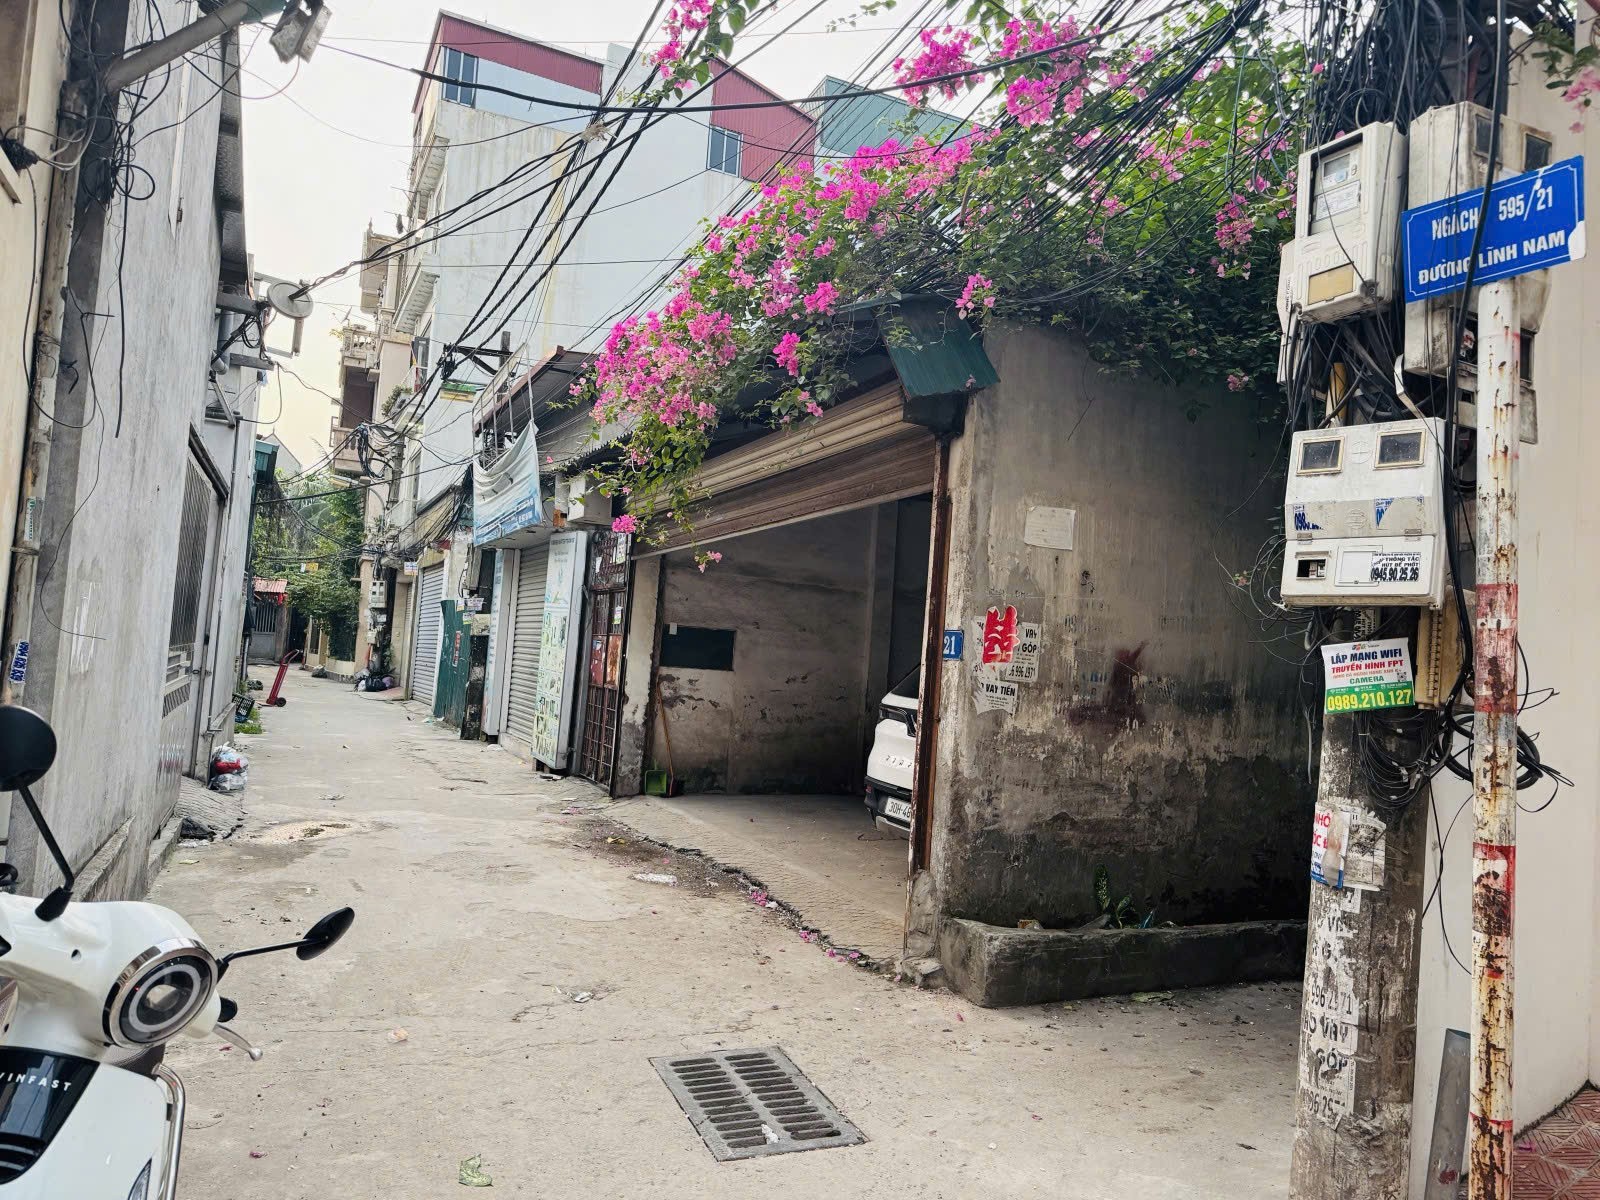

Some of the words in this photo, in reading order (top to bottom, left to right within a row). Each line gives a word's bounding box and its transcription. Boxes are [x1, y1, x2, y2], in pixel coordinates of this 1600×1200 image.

[1432, 207, 1480, 240] NGÁCH
[1418, 257, 1471, 284] ĐƯỜNG
[1478, 243, 1517, 268] LĨNH
[1522, 229, 1565, 256] NAM
[943, 635, 956, 655] 21
[1331, 653, 1348, 664] LẮP
[1350, 650, 1378, 663] MẠNG
[1380, 648, 1402, 659] WIFI
[1364, 661, 1385, 670] HÌNH
[1388, 659, 1404, 667] FPT
[985, 683, 999, 694] VAY
[1349, 676, 1385, 684] CAMERA
[1327, 689, 1412, 711] 0989.210.127
